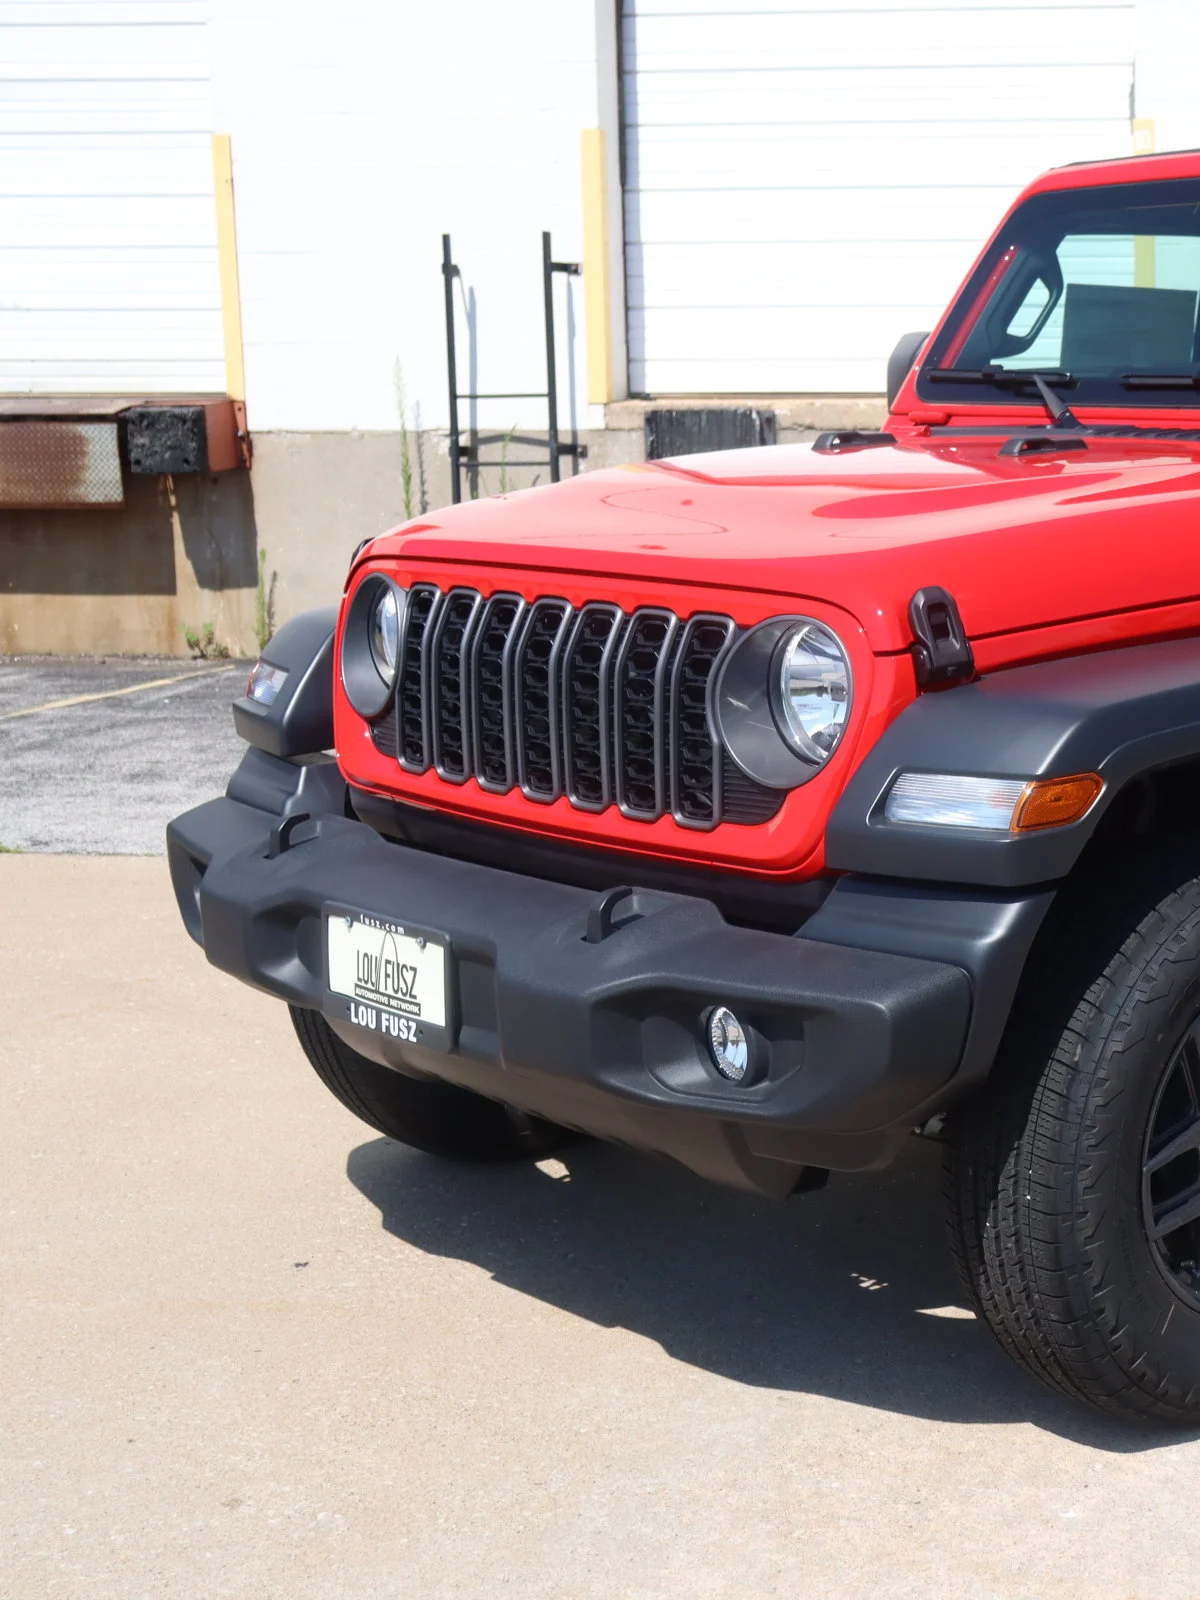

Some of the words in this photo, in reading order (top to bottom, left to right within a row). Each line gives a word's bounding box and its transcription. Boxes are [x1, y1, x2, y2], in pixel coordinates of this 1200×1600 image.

[360, 914, 405, 935] fusz.com
[356, 950, 377, 988] LOU
[385, 958, 417, 1000] FUSZ
[355, 987, 389, 1005] AUTOMOTIVE
[389, 998, 420, 1014] NETWORK
[350, 1002, 377, 1029] LOU
[382, 1012, 417, 1043] FUSZ
